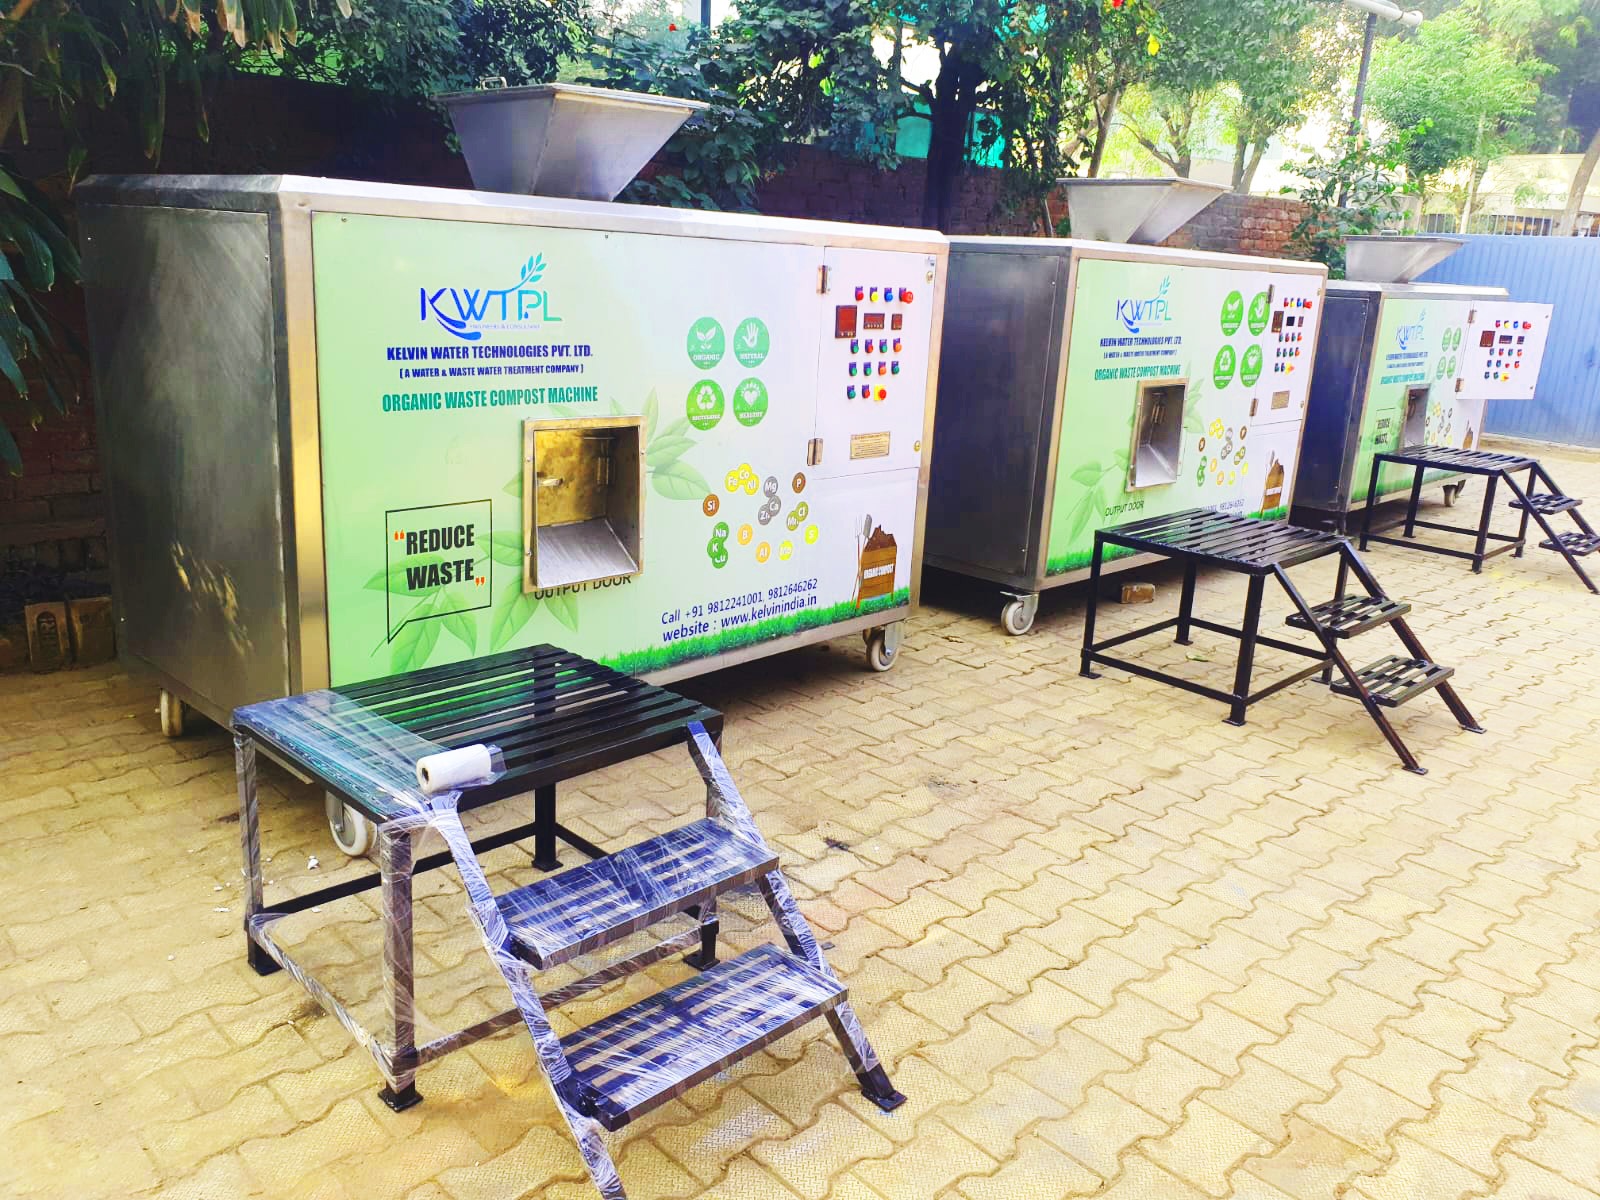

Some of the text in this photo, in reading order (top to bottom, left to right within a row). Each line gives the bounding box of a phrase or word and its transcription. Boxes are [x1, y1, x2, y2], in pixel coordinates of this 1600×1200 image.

[420, 287, 563, 322] KWTPL
[386, 344, 593, 361] KELVIN WATER TECHNOLOGIES PVT. LTD.
[411, 367, 440, 378] WATER
[441, 368, 448, 377] &
[449, 366, 476, 377] WASTE
[477, 366, 503, 376] WATER
[504, 365, 544, 375] TREATMENT
[545, 364, 580, 374] COMPANY
[382, 386, 598, 412] ORGANIC WASTE COMPOST MACHINE
[739, 469, 750, 480] Co
[727, 476, 738, 487] Fe
[796, 479, 802, 489] P
[764, 482, 777, 493] Mg
[707, 500, 716, 511] Si
[715, 528, 727, 538] Na
[742, 529, 748, 540] B
[712, 542, 719, 553] K
[661, 609, 681, 625] Call
[685, 604, 703, 620] +91
[768, 578, 818, 600] 9812646262
[662, 620, 710, 642] website
[720, 592, 818, 629] www.kelvinindia.in
